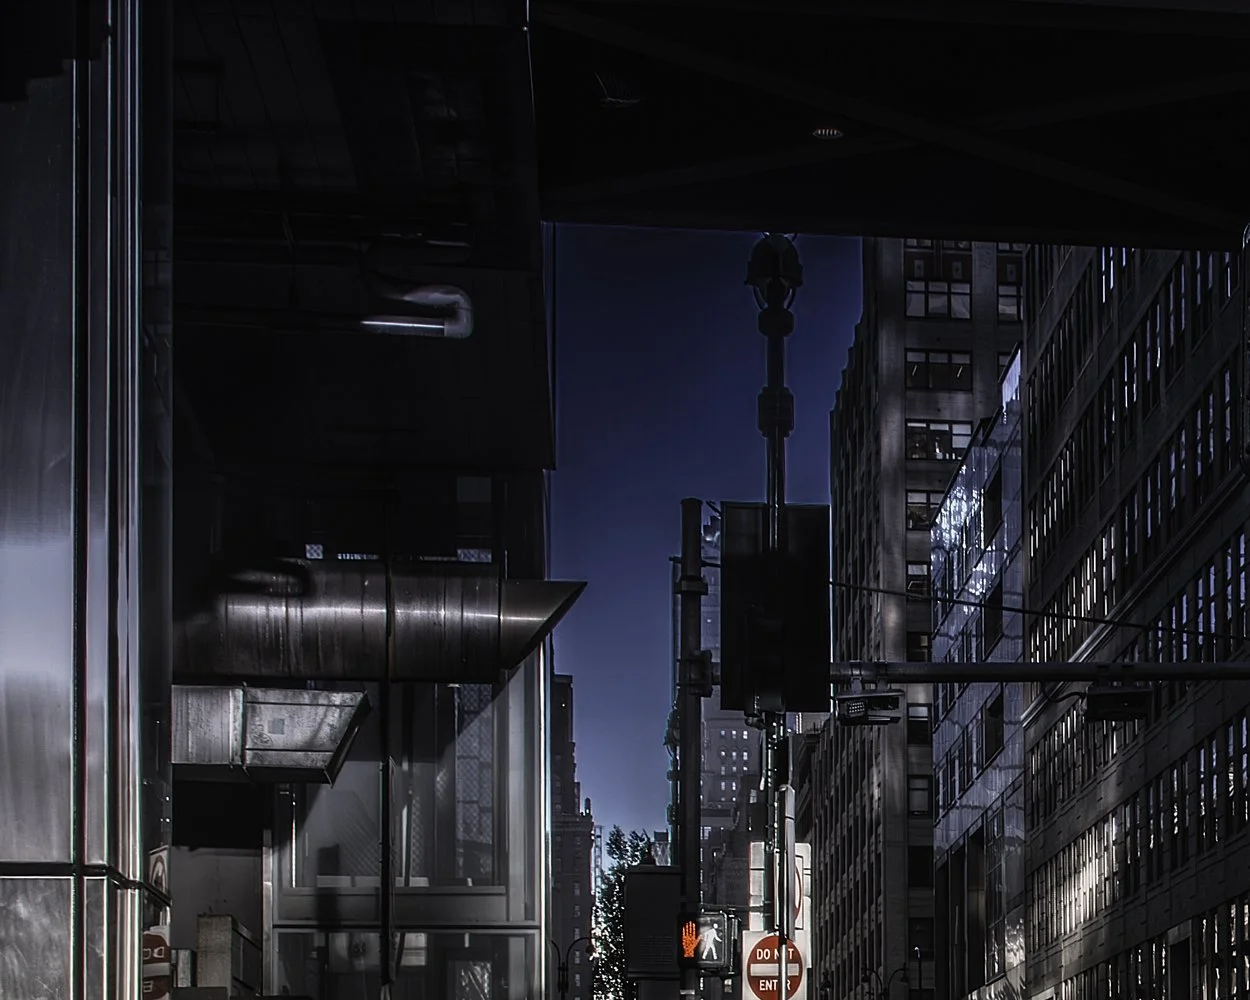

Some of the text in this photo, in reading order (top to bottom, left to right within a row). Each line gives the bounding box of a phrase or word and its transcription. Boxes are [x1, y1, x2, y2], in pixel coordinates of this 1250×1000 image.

[756, 948, 794, 961] DO NT
[759, 979, 791, 992] ENTR
